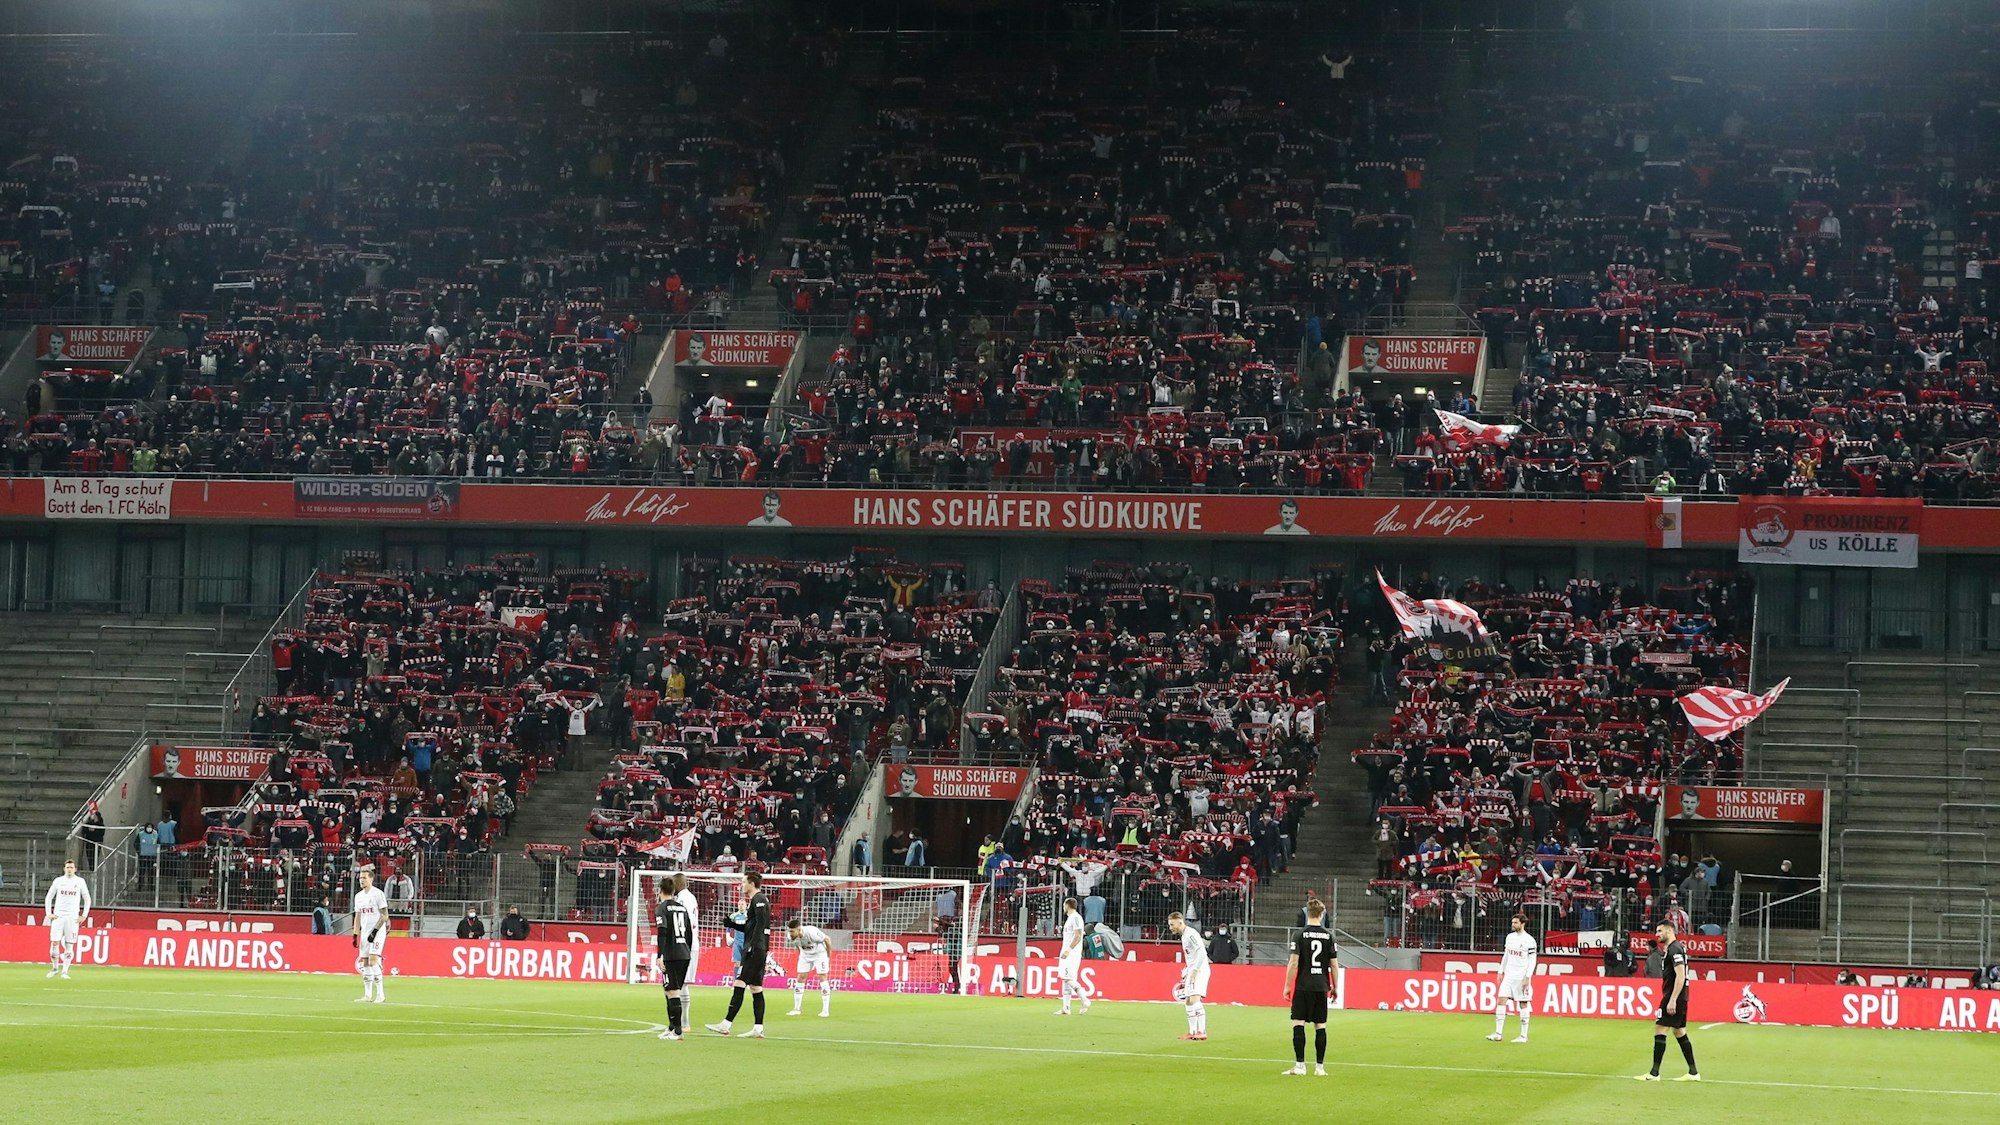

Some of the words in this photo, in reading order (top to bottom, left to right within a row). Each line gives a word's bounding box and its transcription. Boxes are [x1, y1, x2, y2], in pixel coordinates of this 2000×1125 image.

[71, 330, 98, 342] HANS
[711, 334, 740, 347] HANS
[744, 333, 795, 347] SCHÄFER
[70, 343, 125, 358] SÜDKURVE
[1386, 341, 1417, 353] HANS
[1422, 339, 1475, 354] SCHÄFER
[710, 348, 769, 363] SÜDKURVE
[1386, 355, 1448, 370] SÜDKURVE
[54, 480, 76, 493] Am
[81, 480, 92, 494] 8.
[97, 480, 119, 498] Tag
[125, 481, 164, 495] schuf
[300, 481, 427, 497] WILDER-SÜDEN
[48, 499, 75, 513] Gott
[80, 500, 103, 514] den
[109, 501, 115, 514] 1.
[119, 501, 134, 514] FC
[138, 500, 166, 514] Köln
[854, 498, 920, 526] HANS
[931, 494, 1051, 527] SCHÄFER
[1062, 495, 1202, 530] SÜDKURVE
[1803, 513, 1910, 531] PROMINENZ
[1838, 534, 1898, 552] KÖLLE
[195, 750, 223, 762] HANS
[195, 763, 250, 777] SÜDKURVE
[934, 769, 962, 782] HANS
[967, 768, 1017, 783] SCHÄFER
[933, 782, 991, 797] SÜDKURVE
[1717, 791, 1747, 804] HANS
[1752, 790, 1805, 805] SCHÄFER
[1716, 803, 1778, 819] SÜDKURVE
[673, 912, 686, 937] 14
[144, 937, 176, 966] AR
[184, 939, 290, 969] ANDERS.
[1311, 940, 1322, 967] 2
[1568, 941, 1590, 954] UND
[452, 942, 572, 978] SPÜRBAR
[1543, 982, 1658, 1021] ANDERS.
[1842, 989, 1898, 1026] SPÜ
[1939, 997, 1977, 1028] AR
